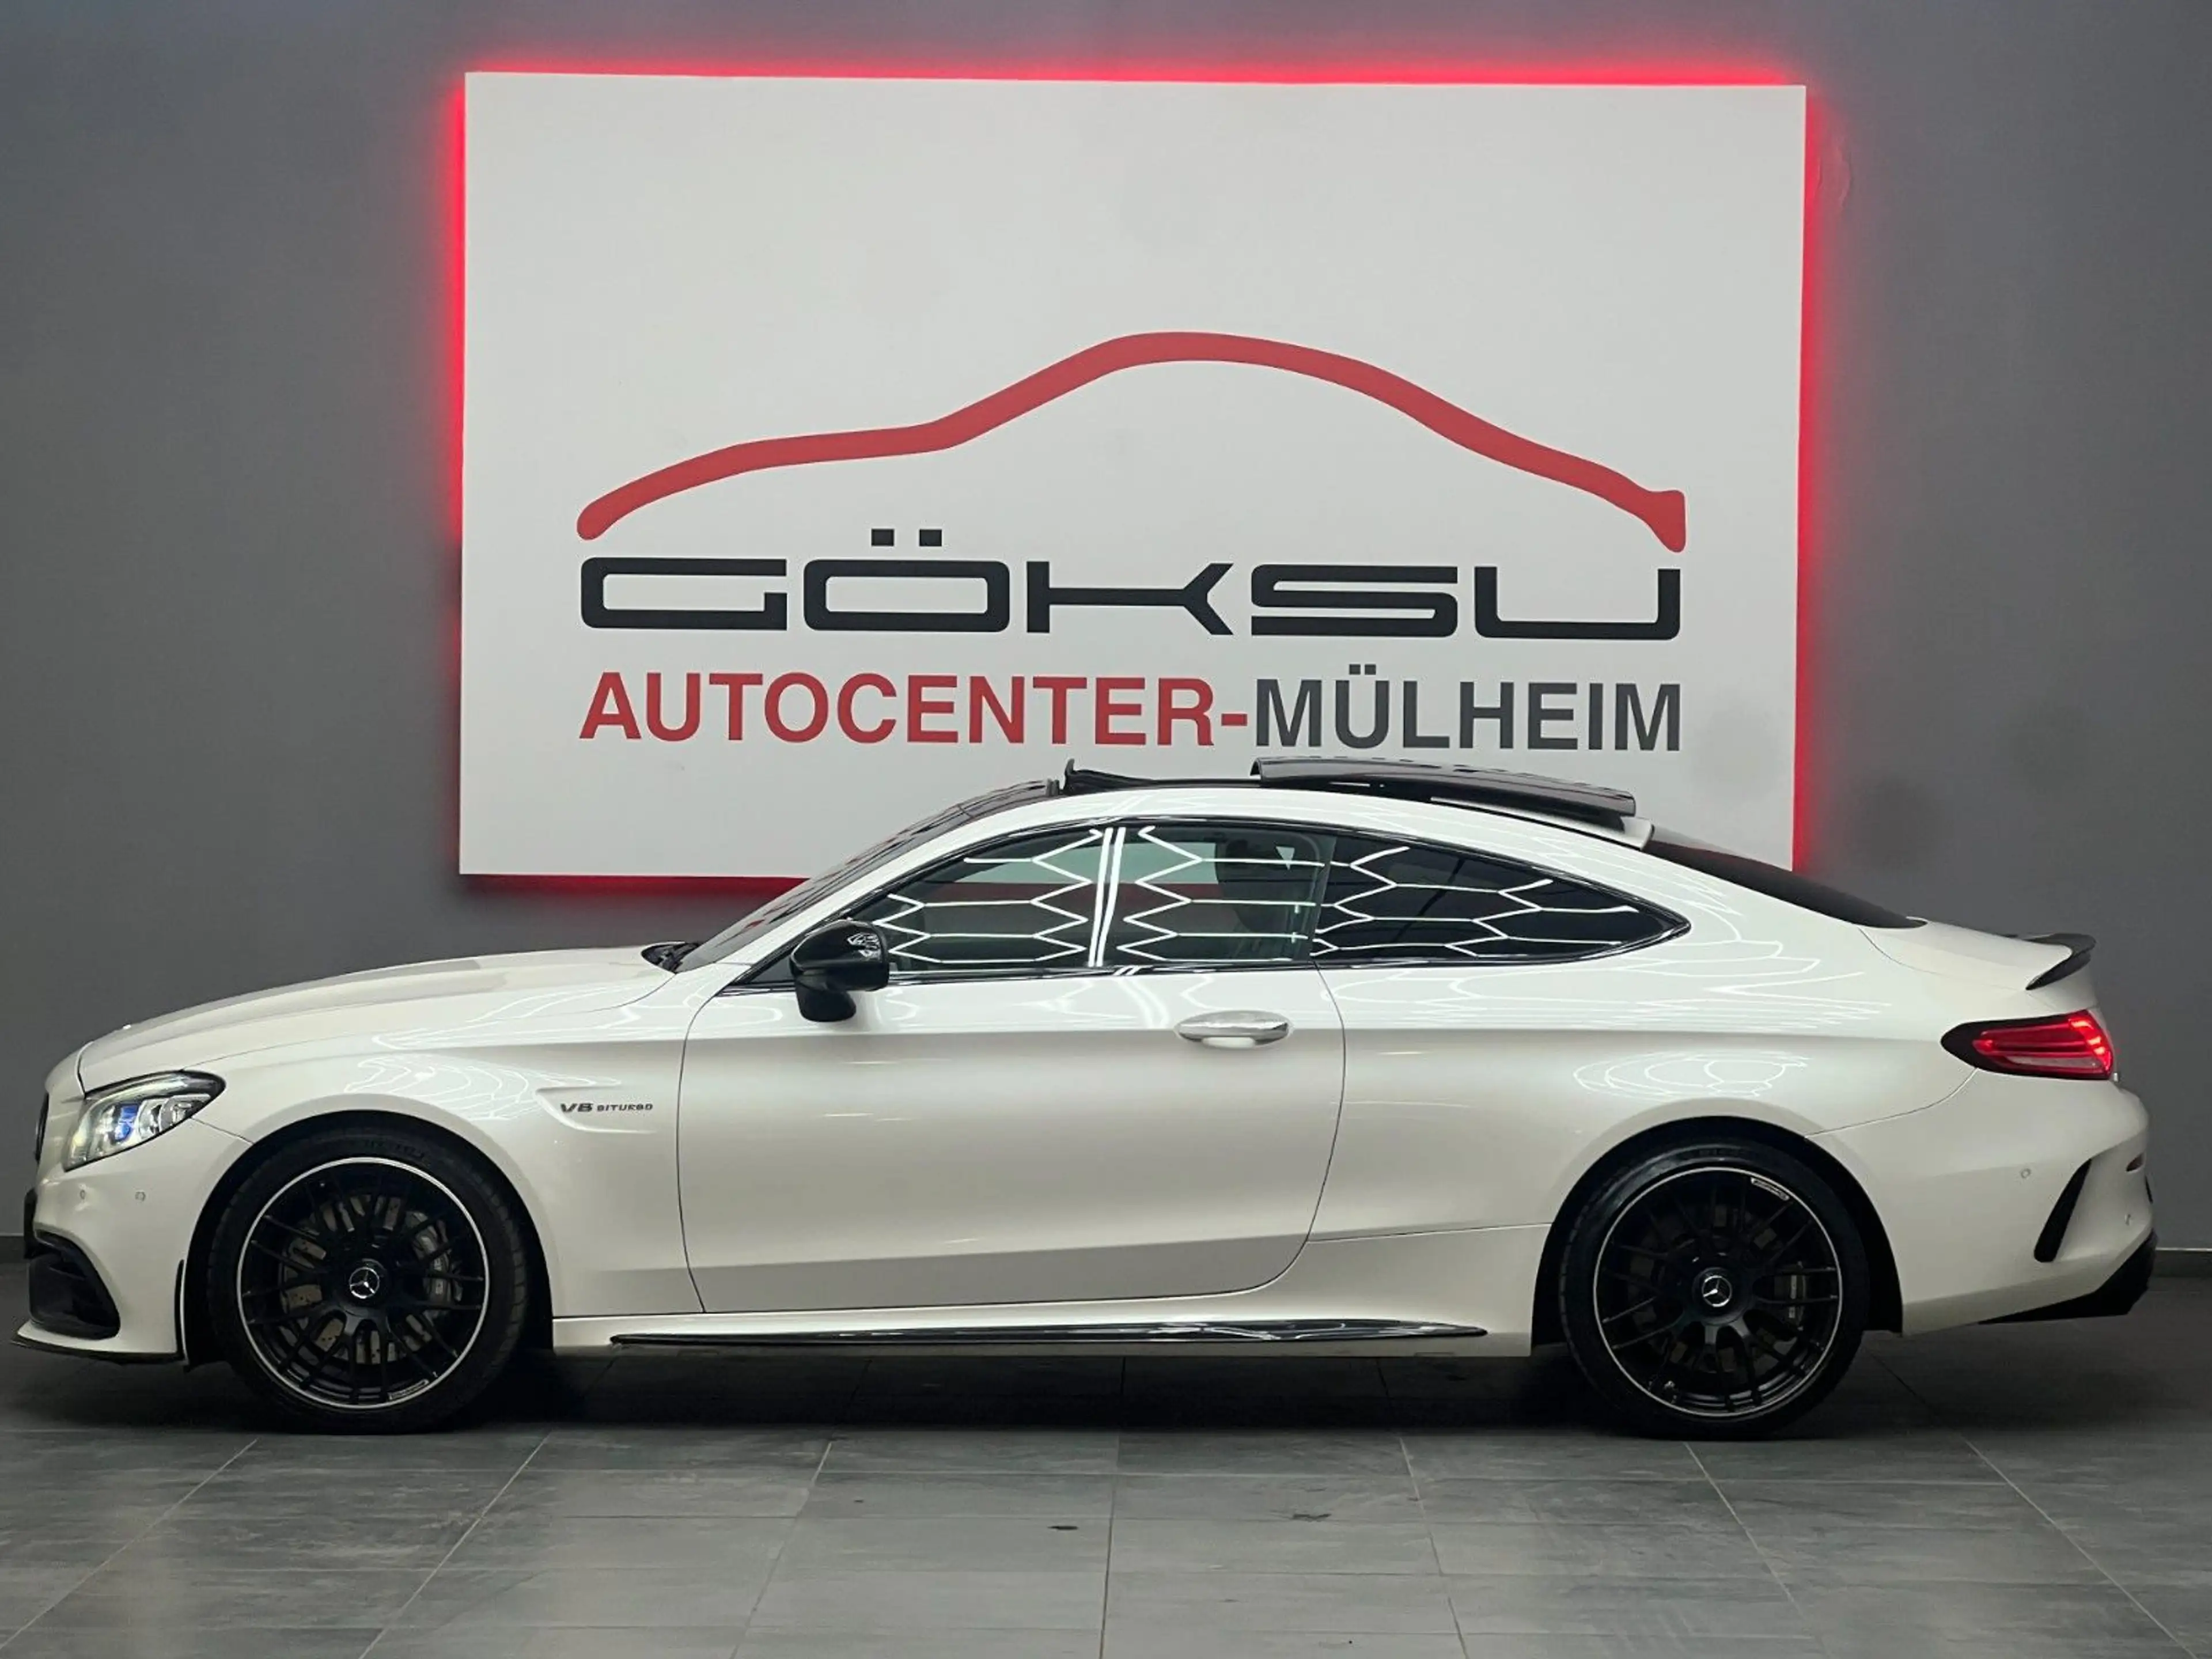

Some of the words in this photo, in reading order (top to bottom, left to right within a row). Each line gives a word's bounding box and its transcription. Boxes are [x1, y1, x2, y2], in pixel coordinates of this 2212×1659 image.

[580, 528, 1681, 641] GÖKSU
[579, 664, 1681, 751] AUTOCENTER-MÜLHEIM
[560, 1103, 593, 1112] V8
[597, 1103, 653, 1112] BITURBO
